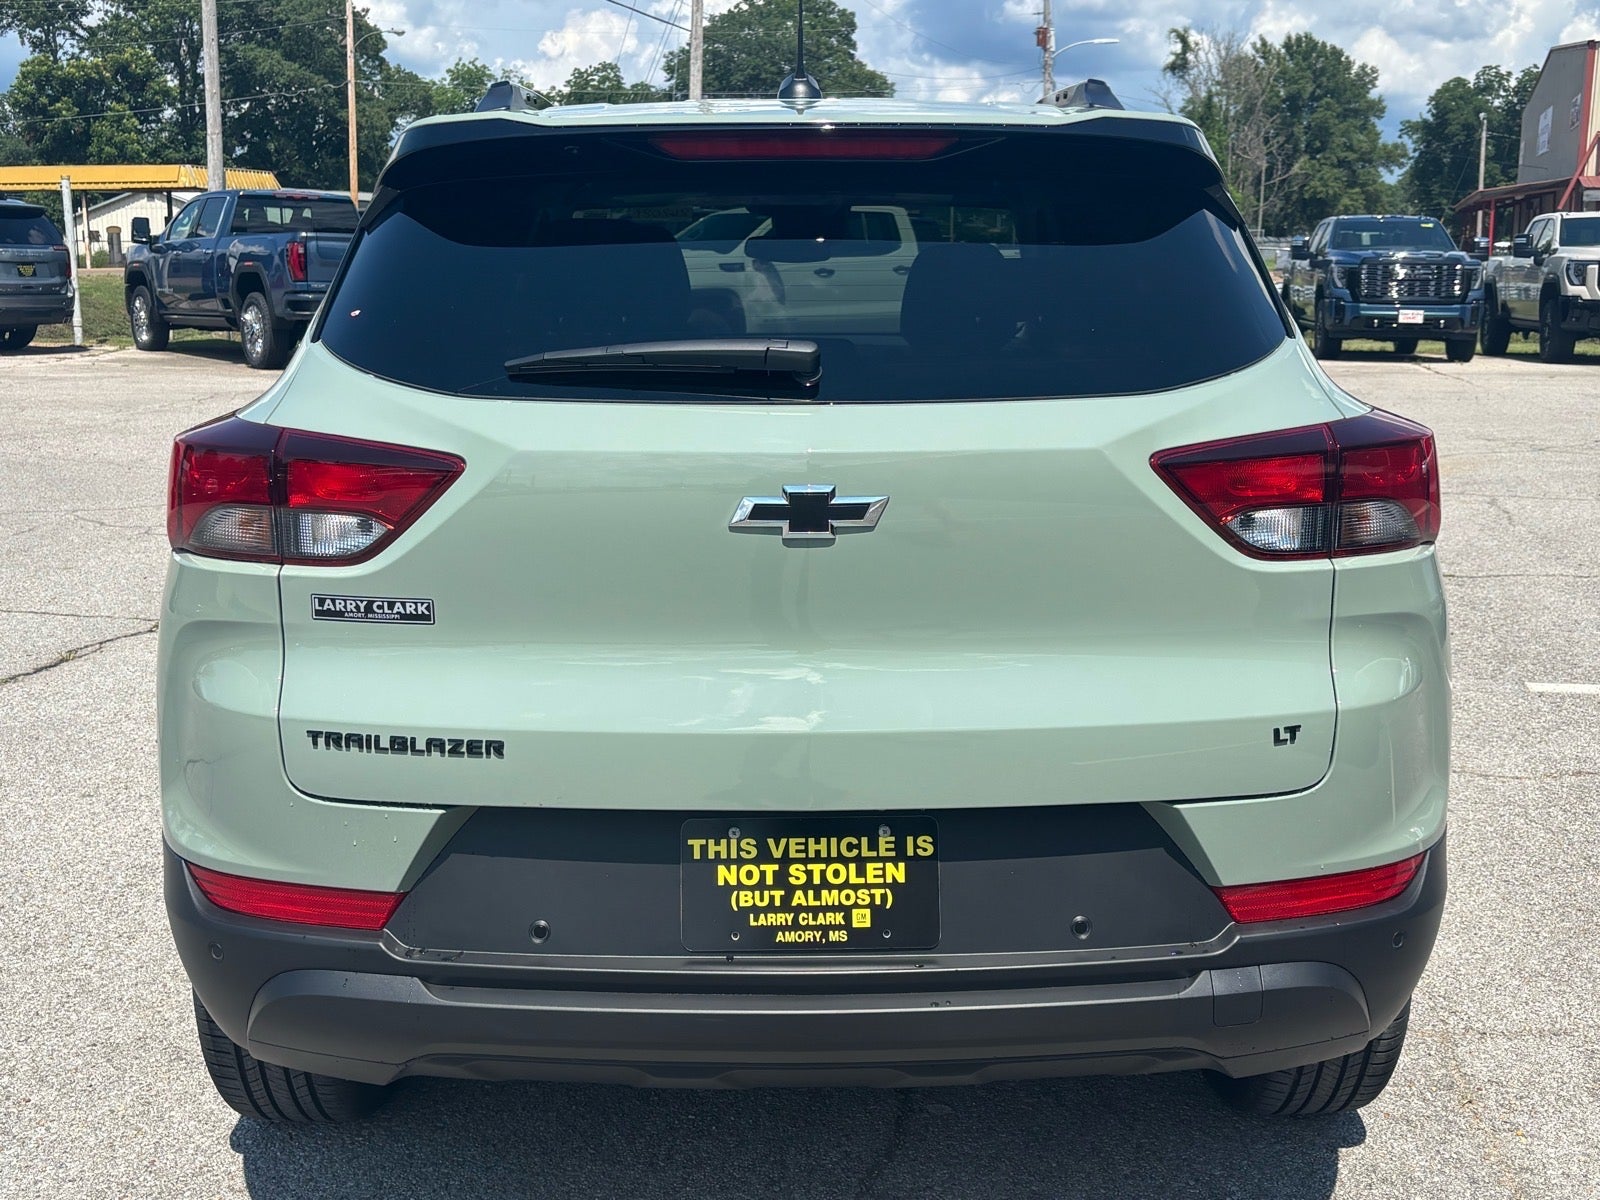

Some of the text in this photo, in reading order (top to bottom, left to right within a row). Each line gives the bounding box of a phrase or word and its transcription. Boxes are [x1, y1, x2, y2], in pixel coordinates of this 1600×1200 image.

[314, 598, 430, 614] LARRY CLARK
[306, 729, 505, 759] TRAILBLAZER
[1273, 725, 1301, 747] LT
[687, 835, 935, 860] THIS VEHICLE IS
[717, 862, 906, 886] NOT STOLEN
[730, 888, 893, 911] (BUT ALMOST)
[749, 911, 846, 926] LARRY CLARK
[855, 912, 867, 921] GM
[775, 930, 848, 944] AMORY, MS
